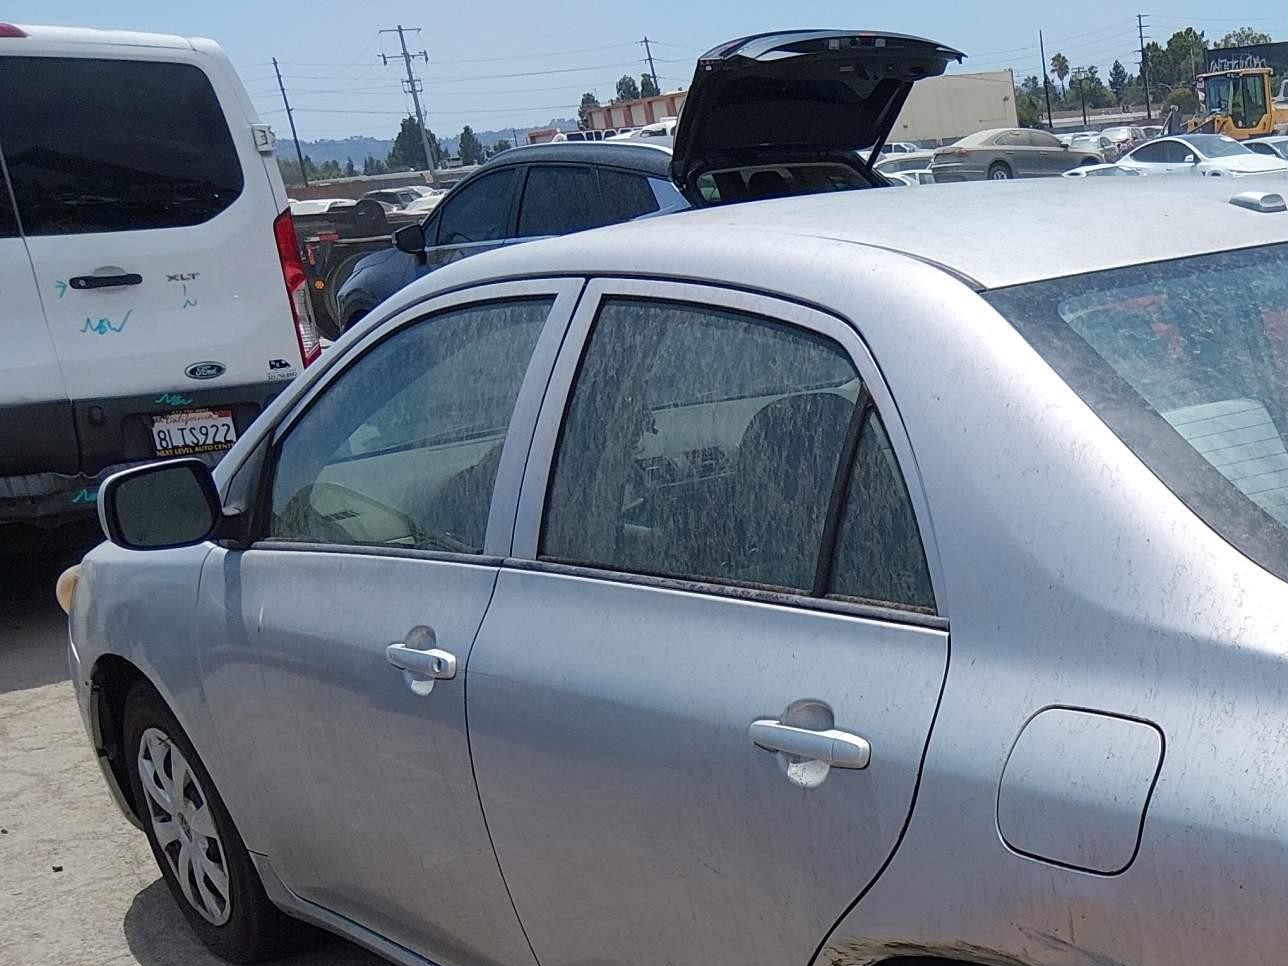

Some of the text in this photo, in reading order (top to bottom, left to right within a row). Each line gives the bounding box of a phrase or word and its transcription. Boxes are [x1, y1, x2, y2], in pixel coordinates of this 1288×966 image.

[166, 272, 200, 282] XLT
[195, 366, 217, 377] Ford
[156, 449, 173, 457] NEXT
[174, 447, 194, 455] LEVEL
